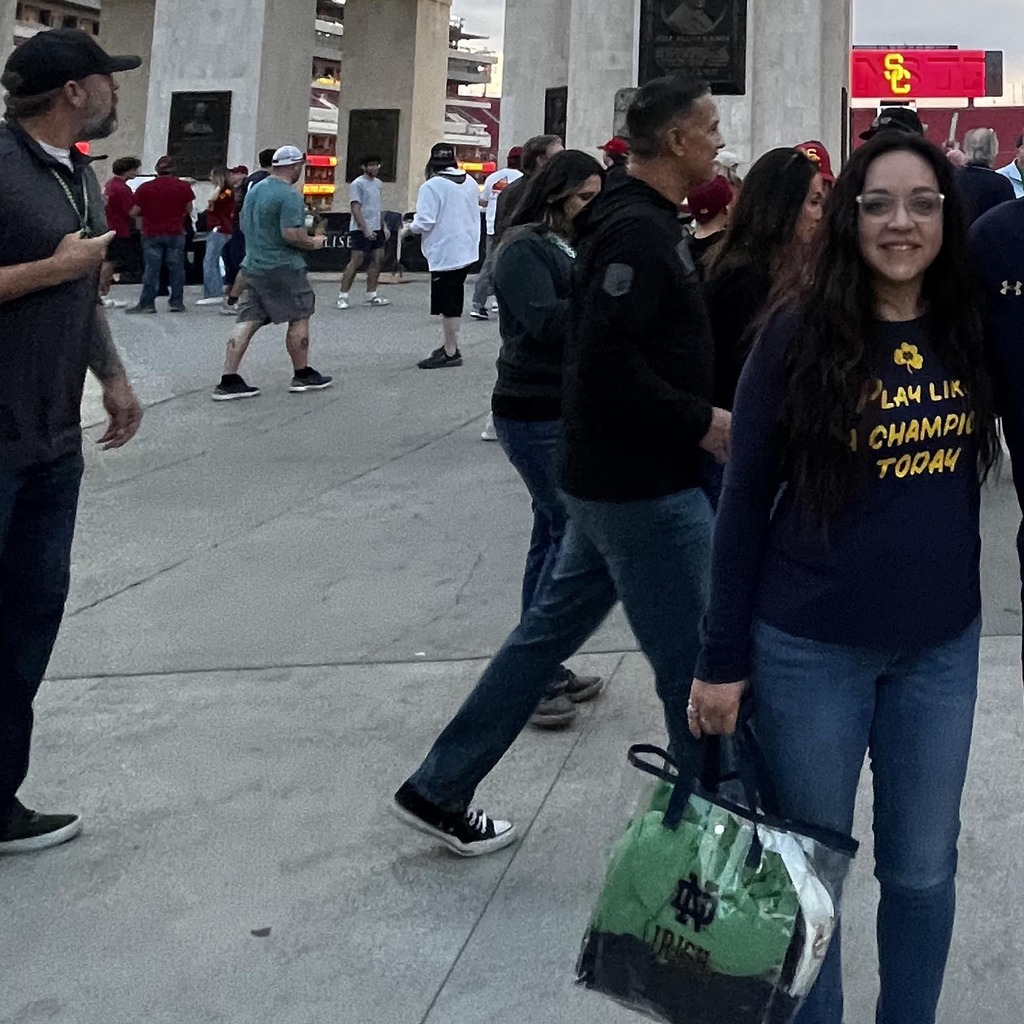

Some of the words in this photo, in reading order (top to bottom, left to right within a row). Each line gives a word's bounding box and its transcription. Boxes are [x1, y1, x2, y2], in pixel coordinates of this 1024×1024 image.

[884, 53, 912, 94] SC
[323, 235, 352, 249] LISE
[929, 379, 965, 401] LIK
[868, 409, 975, 450] CHAMPIO
[875, 446, 962, 479] TODAY
